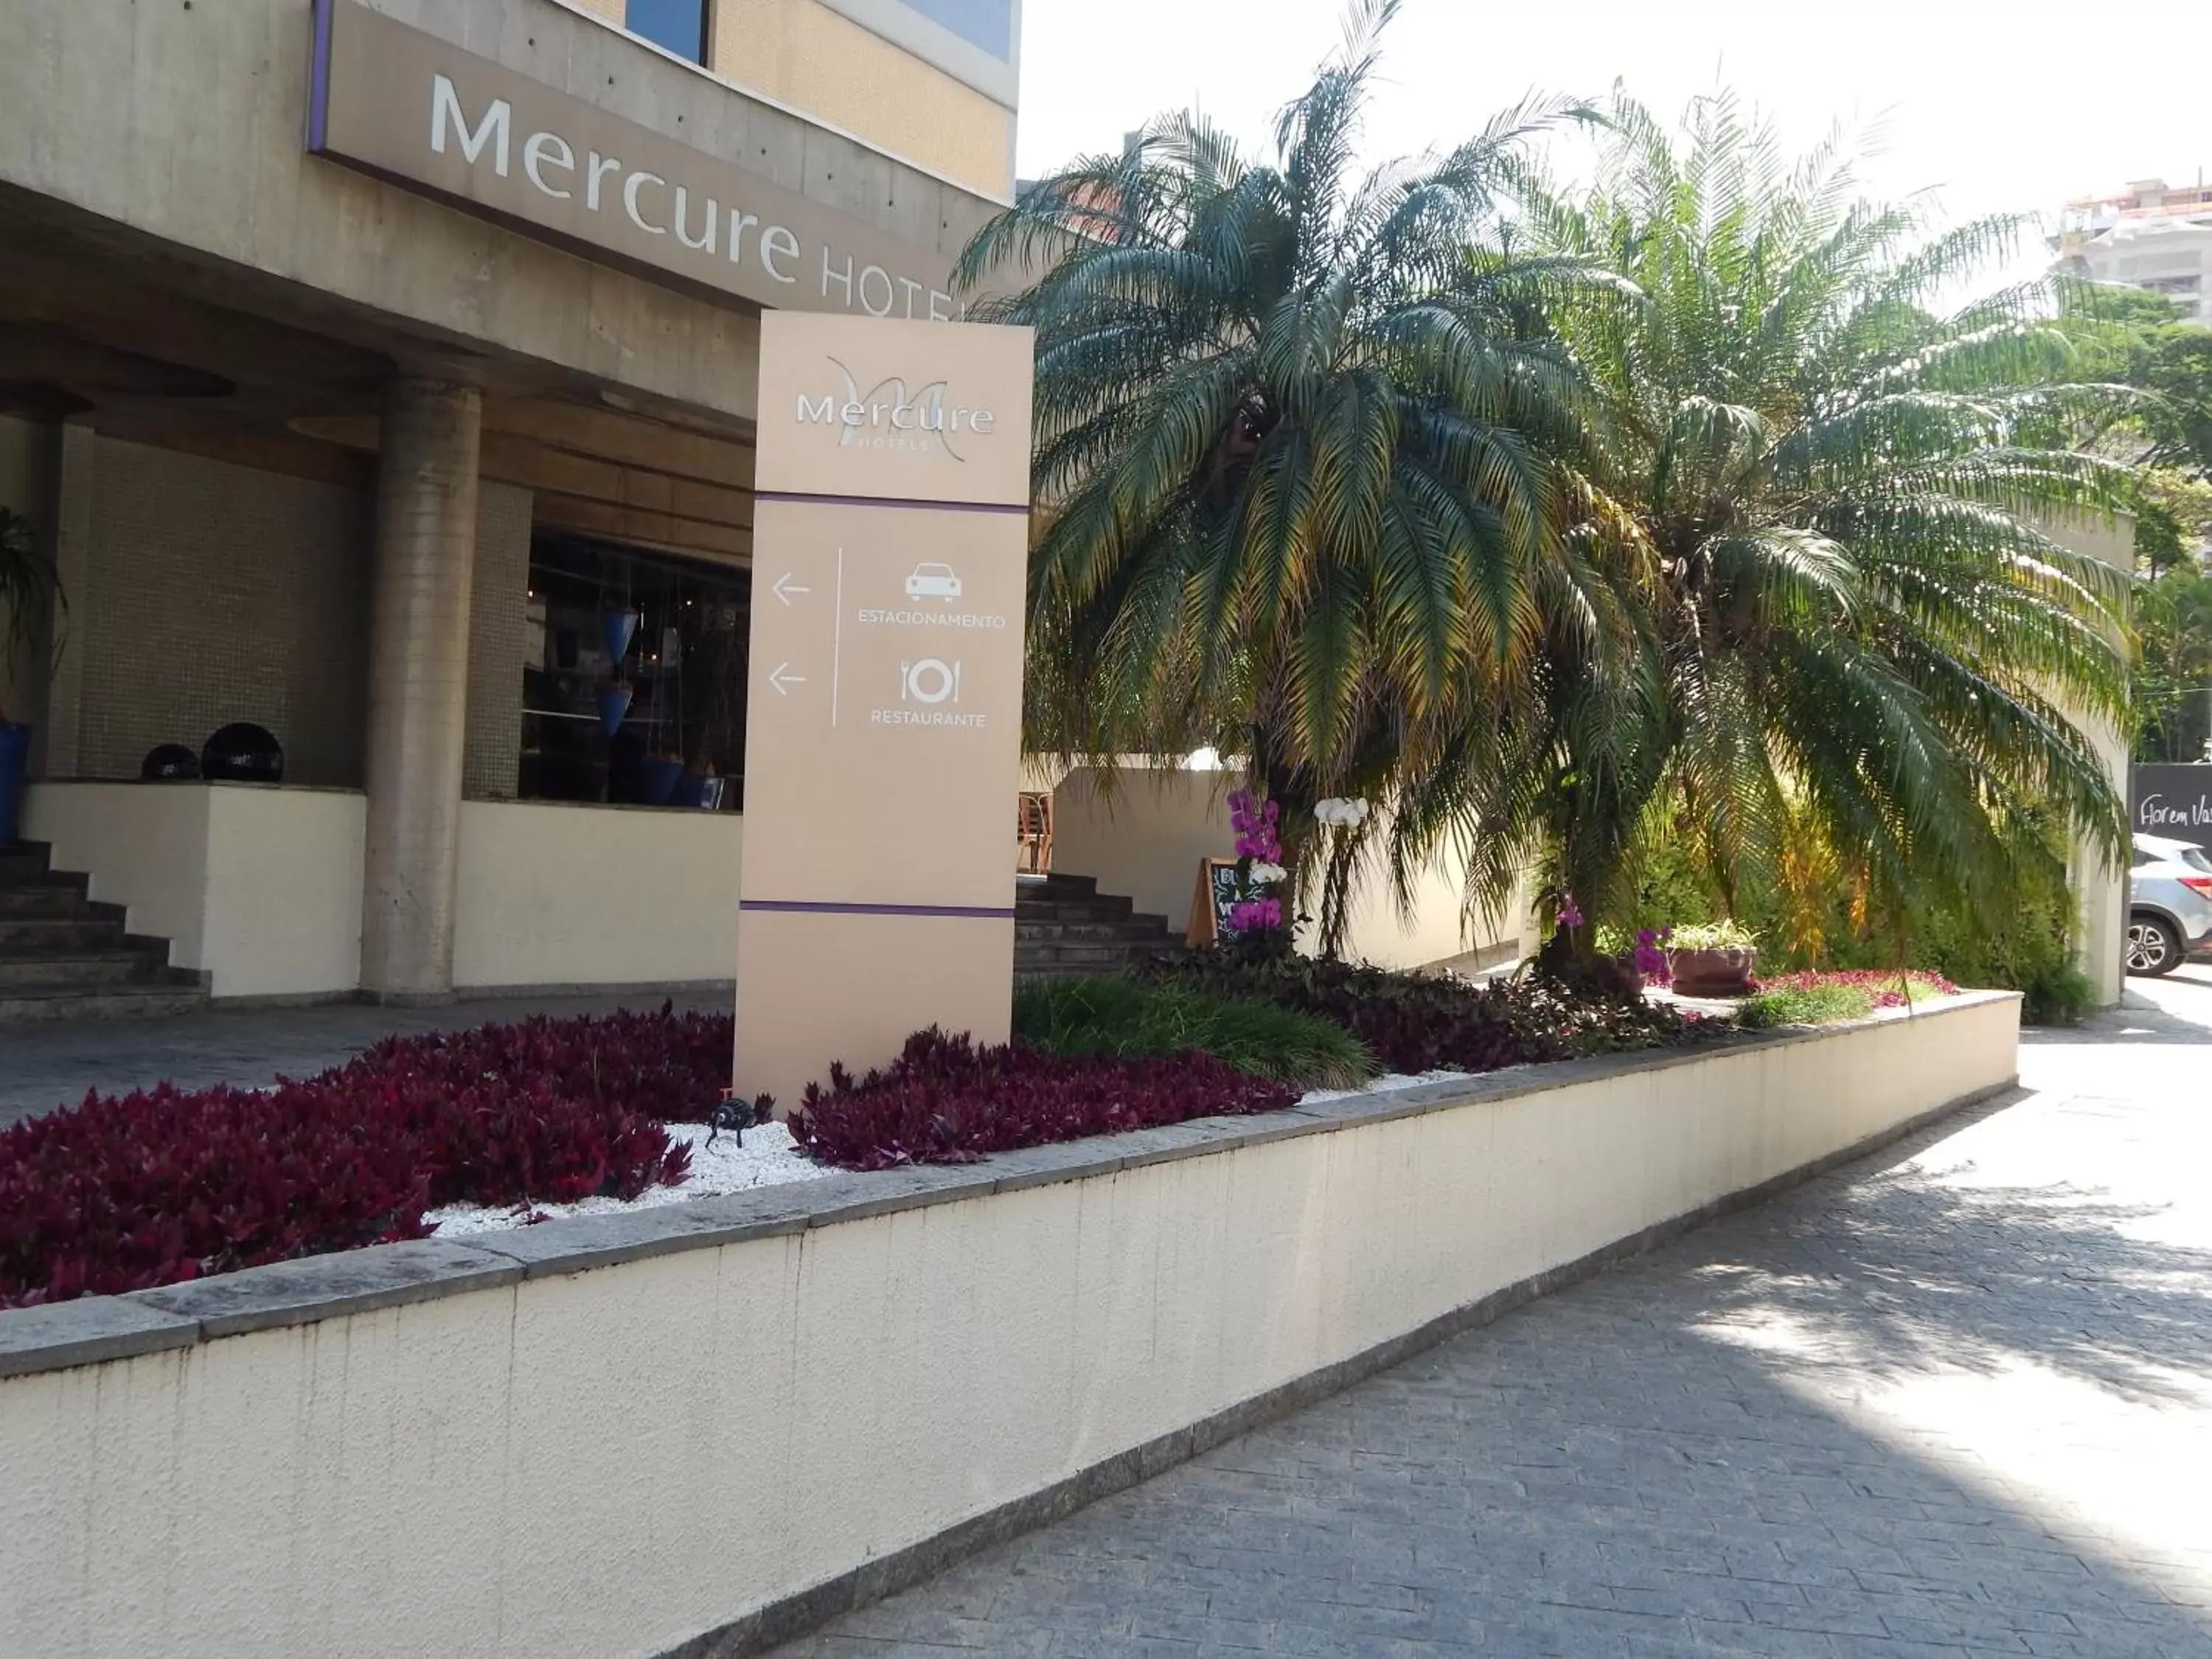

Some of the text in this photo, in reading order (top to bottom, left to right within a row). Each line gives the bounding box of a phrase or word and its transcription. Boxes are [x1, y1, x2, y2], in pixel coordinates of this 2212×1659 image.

[430, 73, 800, 284] Mercure
[796, 393, 994, 434] Mercure
[860, 437, 930, 451] HOTELS
[858, 610, 1006, 627] ESTACIONAMENTO
[871, 709, 987, 727] RESTAURANTE
